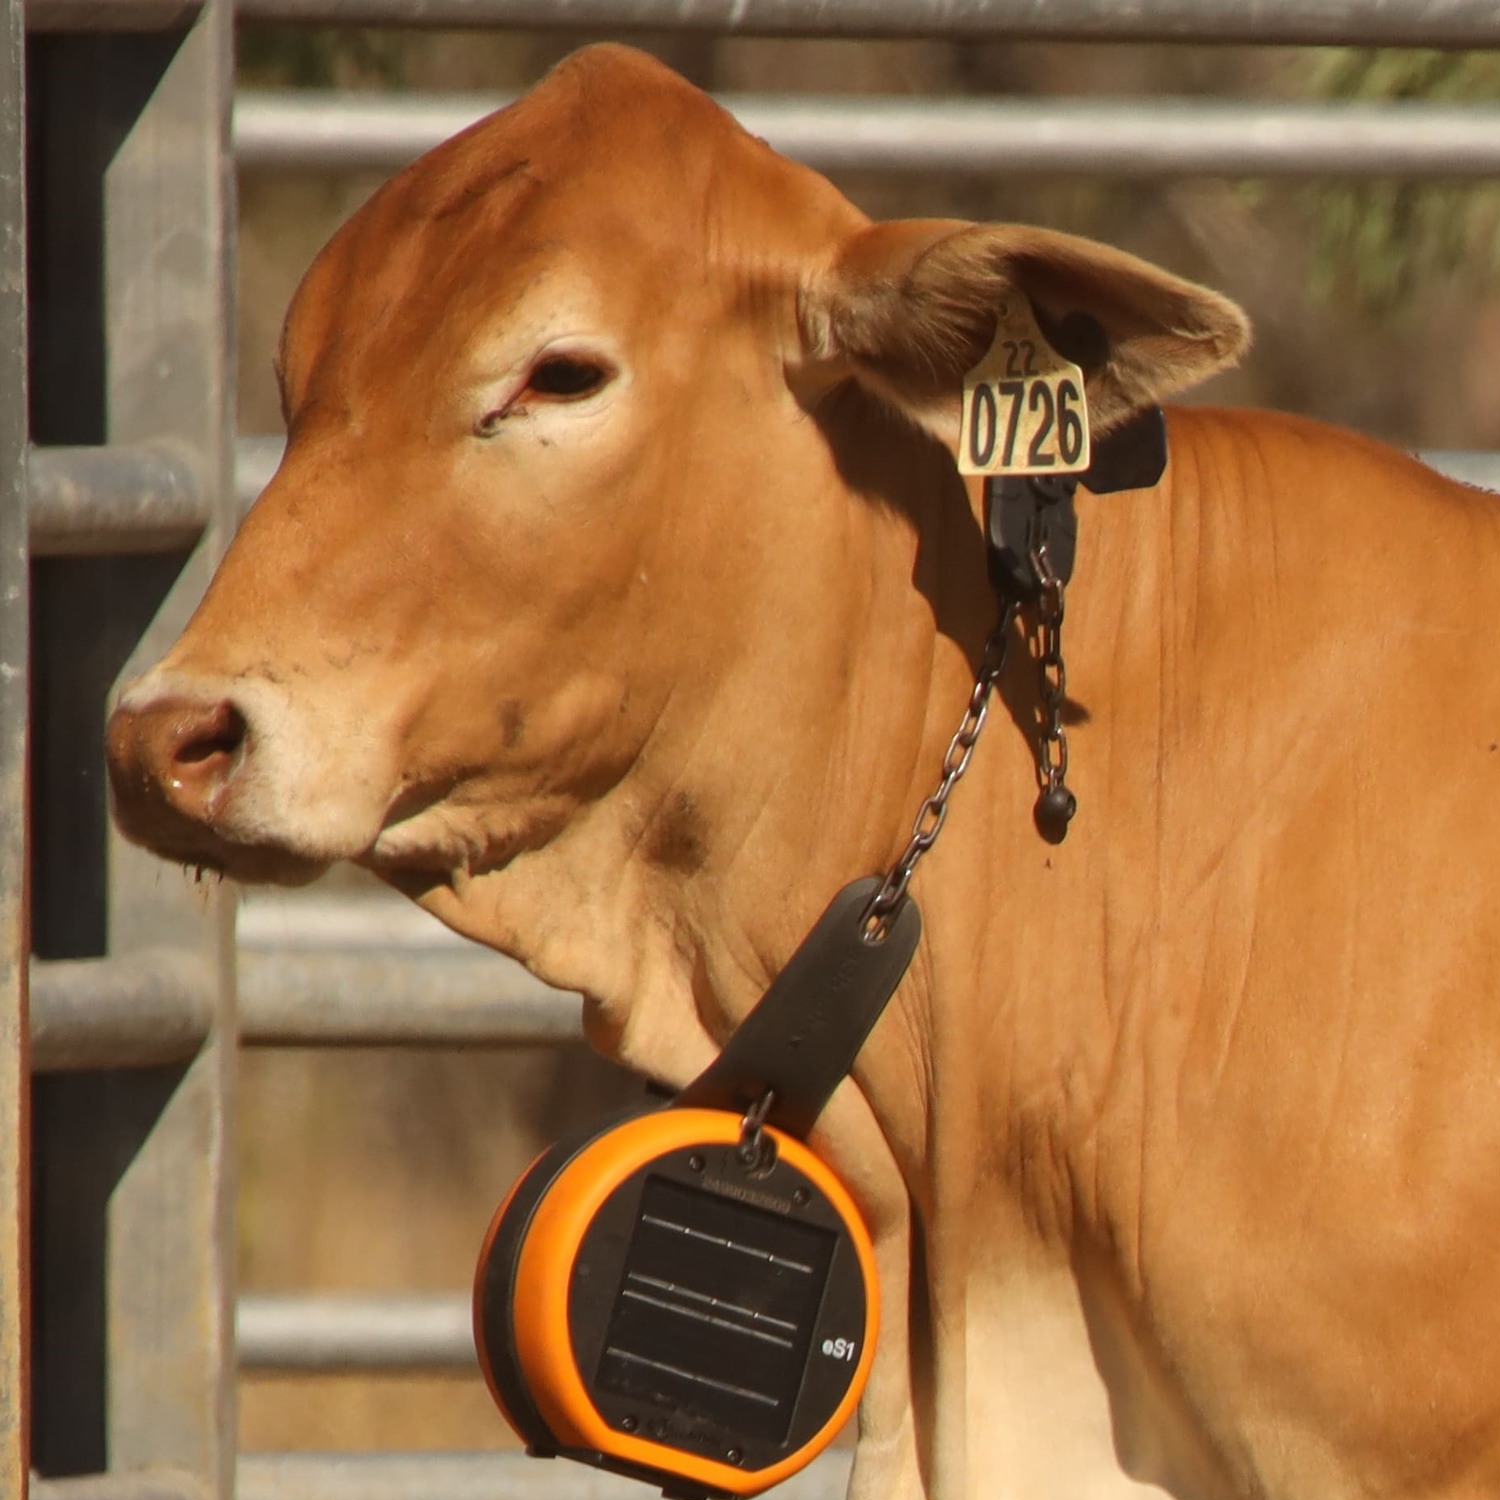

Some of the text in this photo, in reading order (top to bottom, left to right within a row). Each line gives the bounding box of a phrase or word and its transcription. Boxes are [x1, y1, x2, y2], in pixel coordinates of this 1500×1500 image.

[1003, 339, 1040, 378] 22
[969, 378, 1083, 467] 0726
[822, 1337, 855, 1362] eS1
